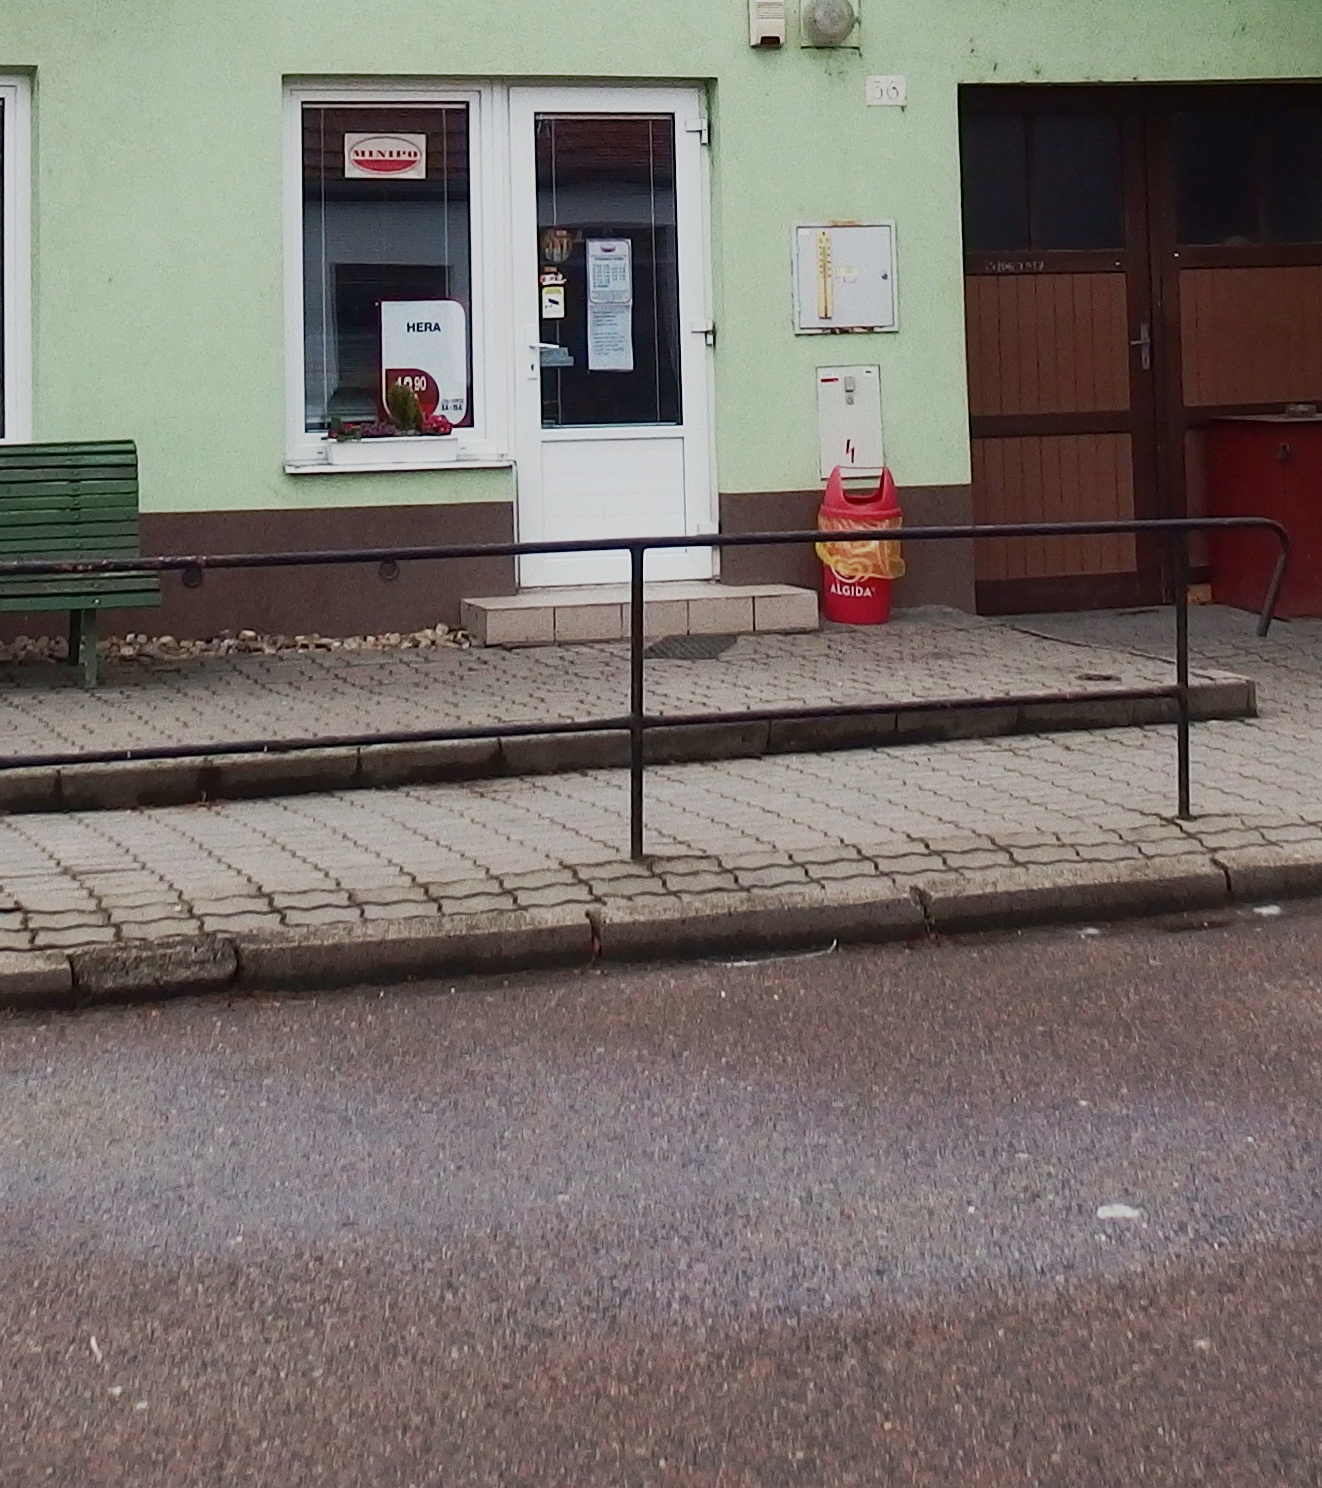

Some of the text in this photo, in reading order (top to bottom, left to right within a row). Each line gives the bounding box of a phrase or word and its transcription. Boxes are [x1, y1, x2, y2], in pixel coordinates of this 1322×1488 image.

[353, 150, 418, 158] MINIPO
[406, 322, 441, 333] HERA
[830, 583, 873, 597] ALGIDA
